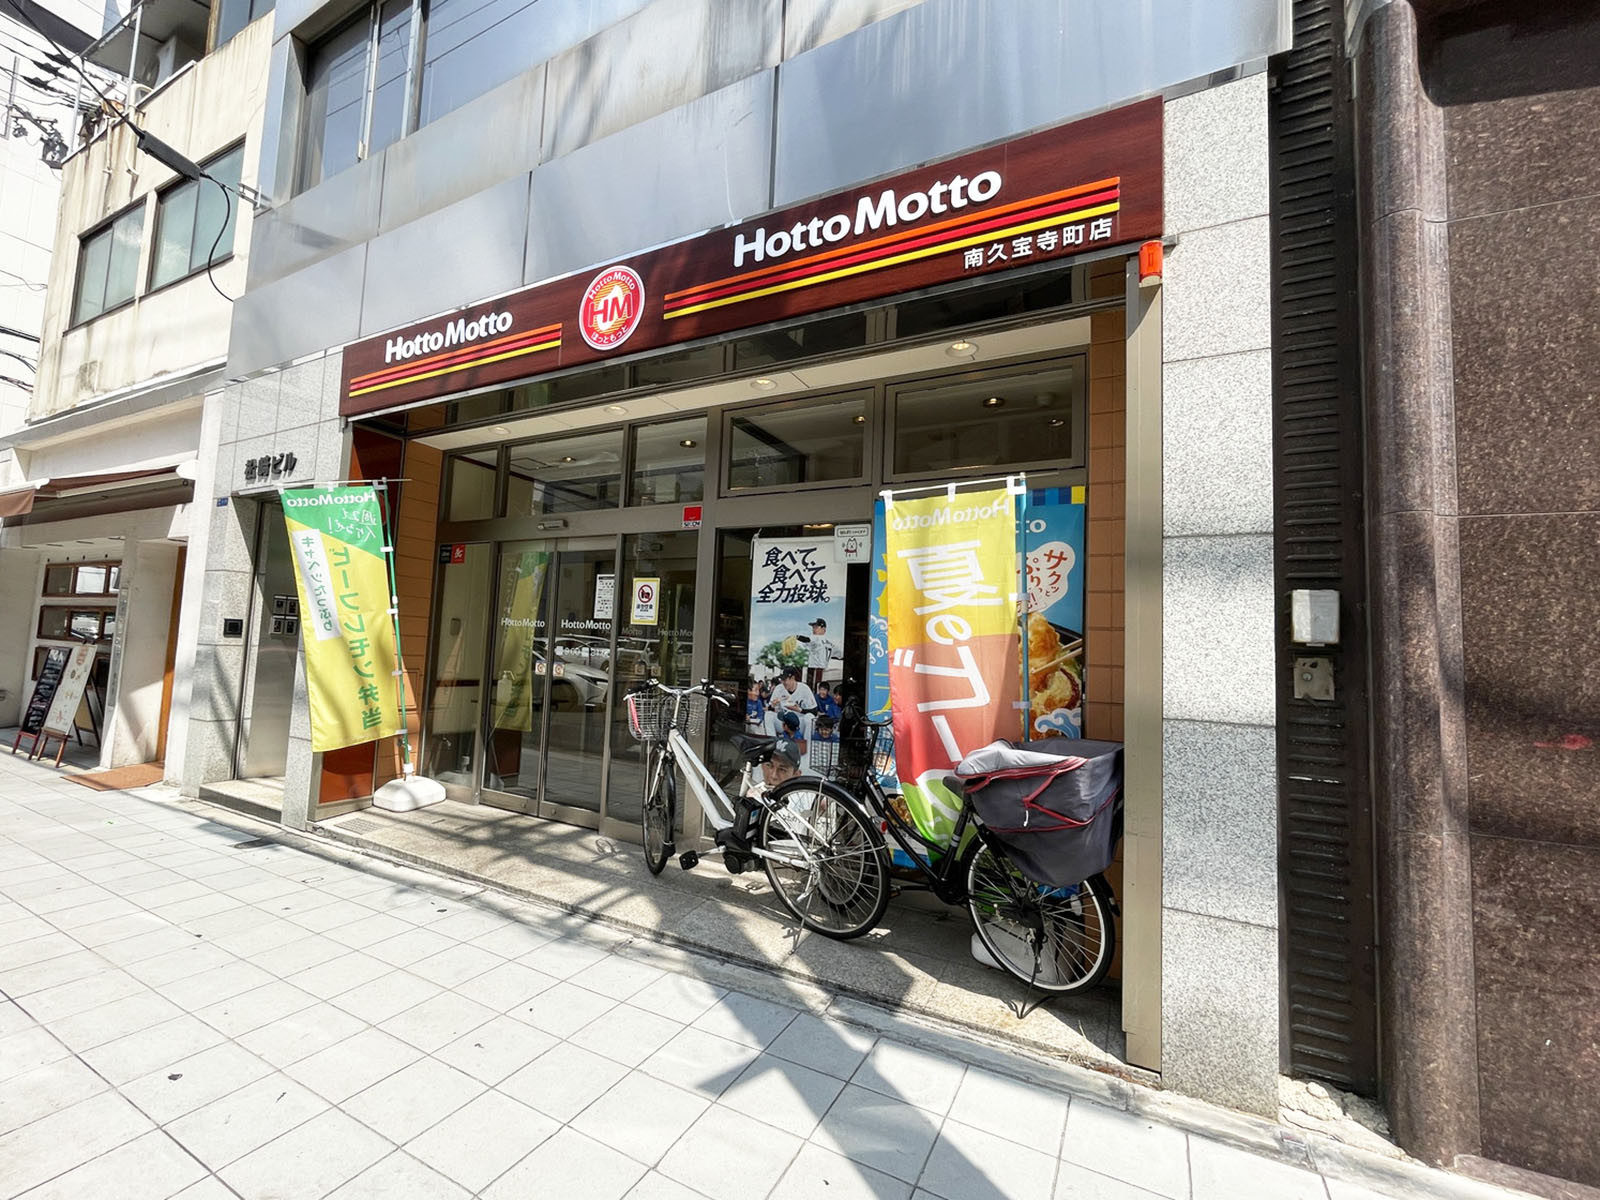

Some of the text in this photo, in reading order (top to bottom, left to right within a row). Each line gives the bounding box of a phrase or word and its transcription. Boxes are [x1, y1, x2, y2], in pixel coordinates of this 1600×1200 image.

[733, 170, 1003, 268] HottoMotto
[963, 218, 1113, 269] 南久宝寺町店
[384, 310, 513, 364] HottoMotto
[591, 325, 629, 344] ほっともっと
[756, 581, 830, 603] 全力投球。
[1044, 549, 1068, 597] サクッと
